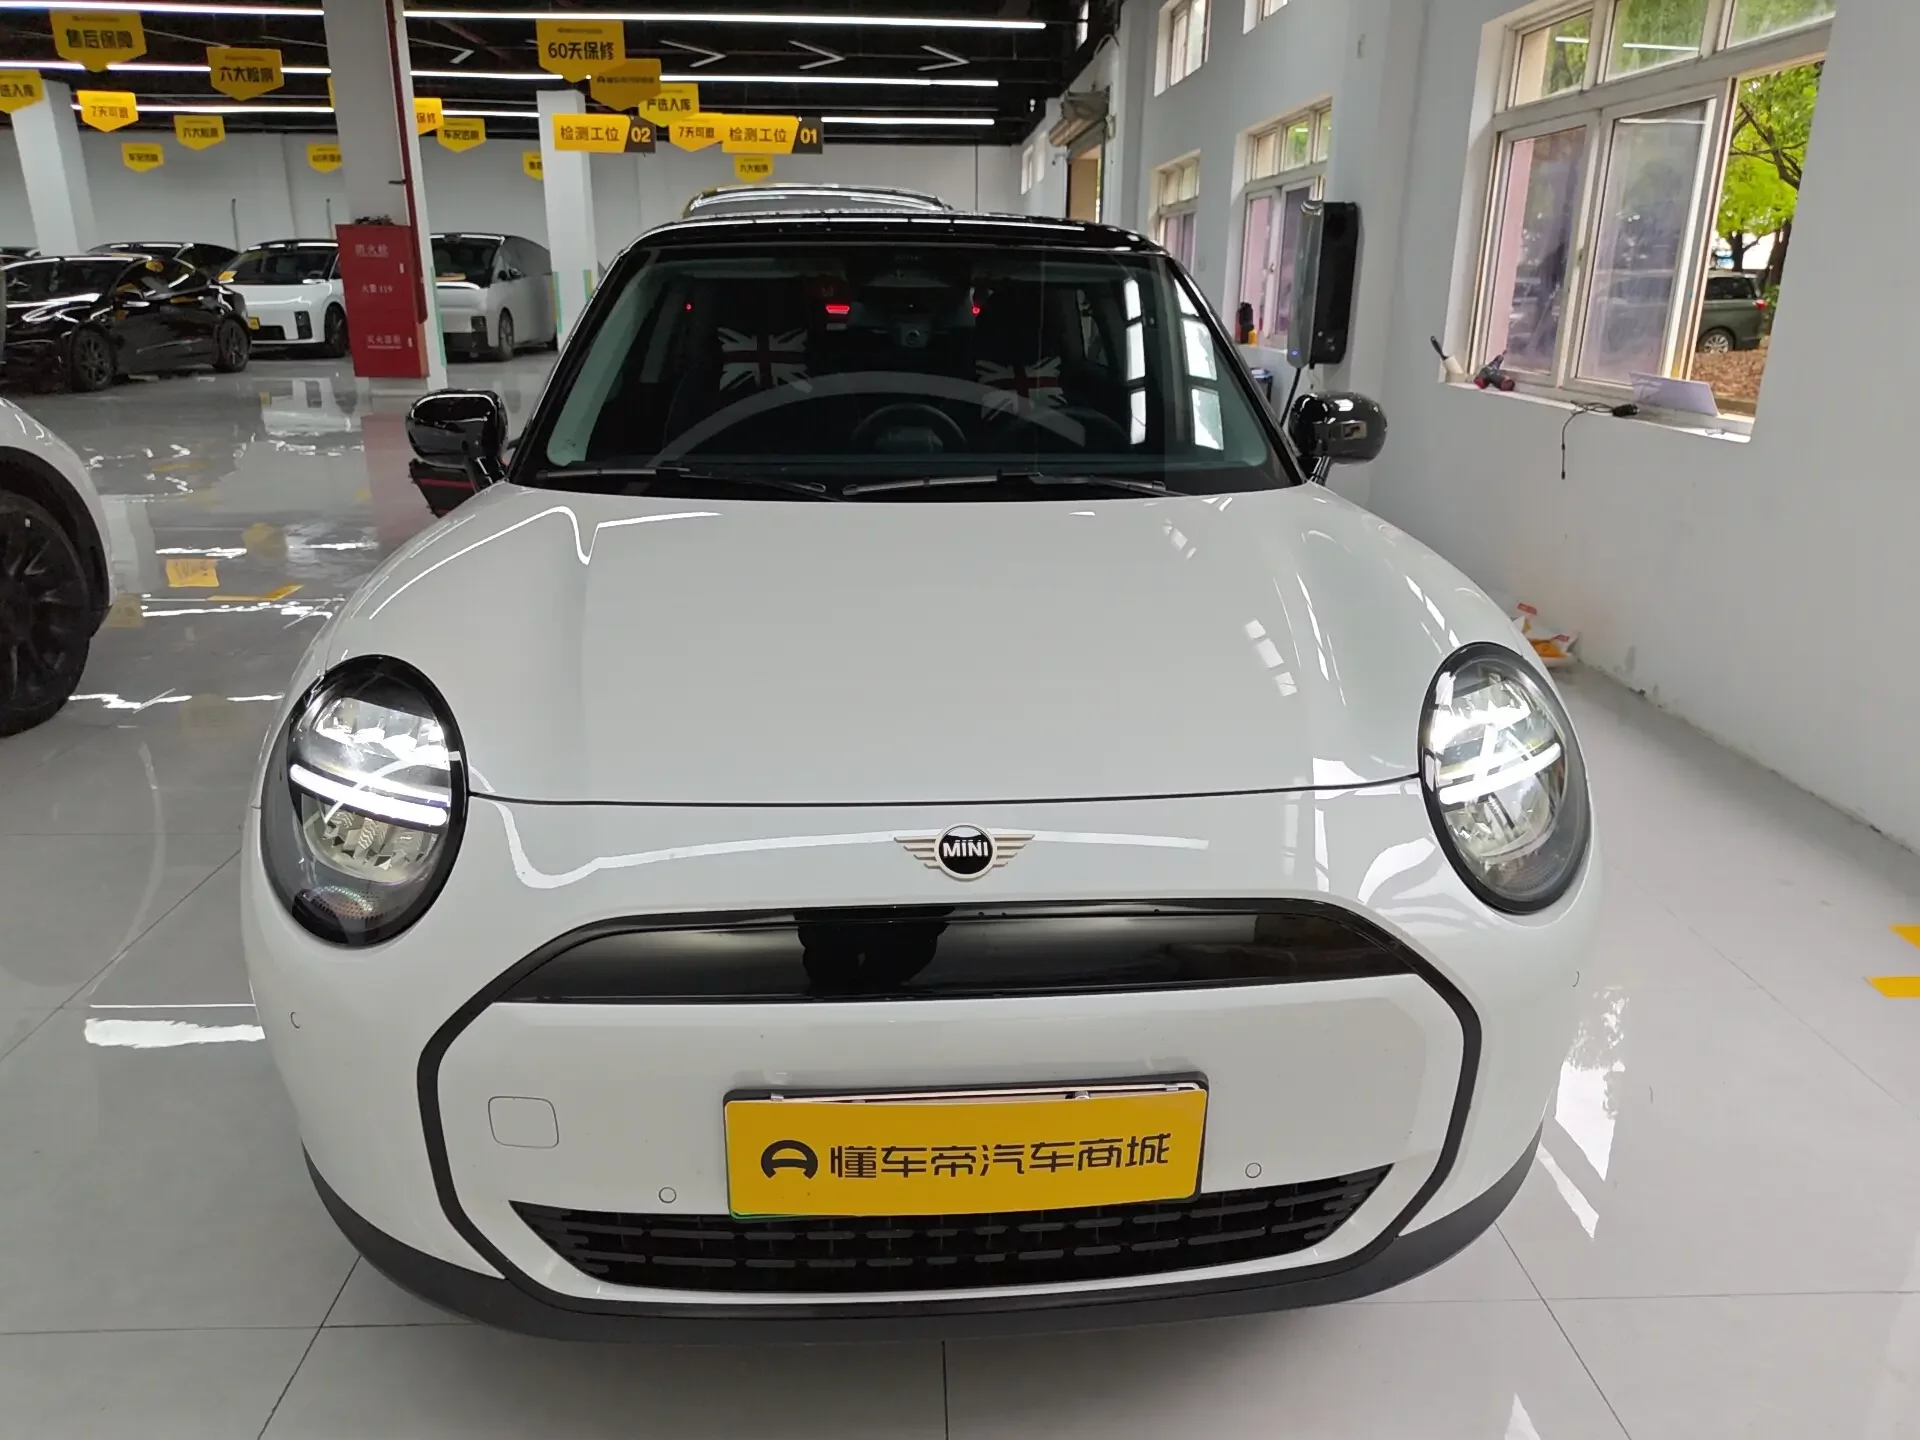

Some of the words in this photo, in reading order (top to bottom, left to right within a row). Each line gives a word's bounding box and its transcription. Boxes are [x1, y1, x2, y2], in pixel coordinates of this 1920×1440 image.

[66, 29, 132, 49] 售后保障
[548, 42, 614, 60] 60天保修
[219, 66, 274, 83] 六大检测
[647, 98, 691, 112] 严选入库
[560, 126, 620, 142] 检测工位
[631, 127, 651, 143] 02
[729, 127, 788, 143] 检测工位
[801, 128, 817, 144] 01
[943, 841, 989, 858] MINI
[830, 1133, 1172, 1179] 懂车帝汽车商城
